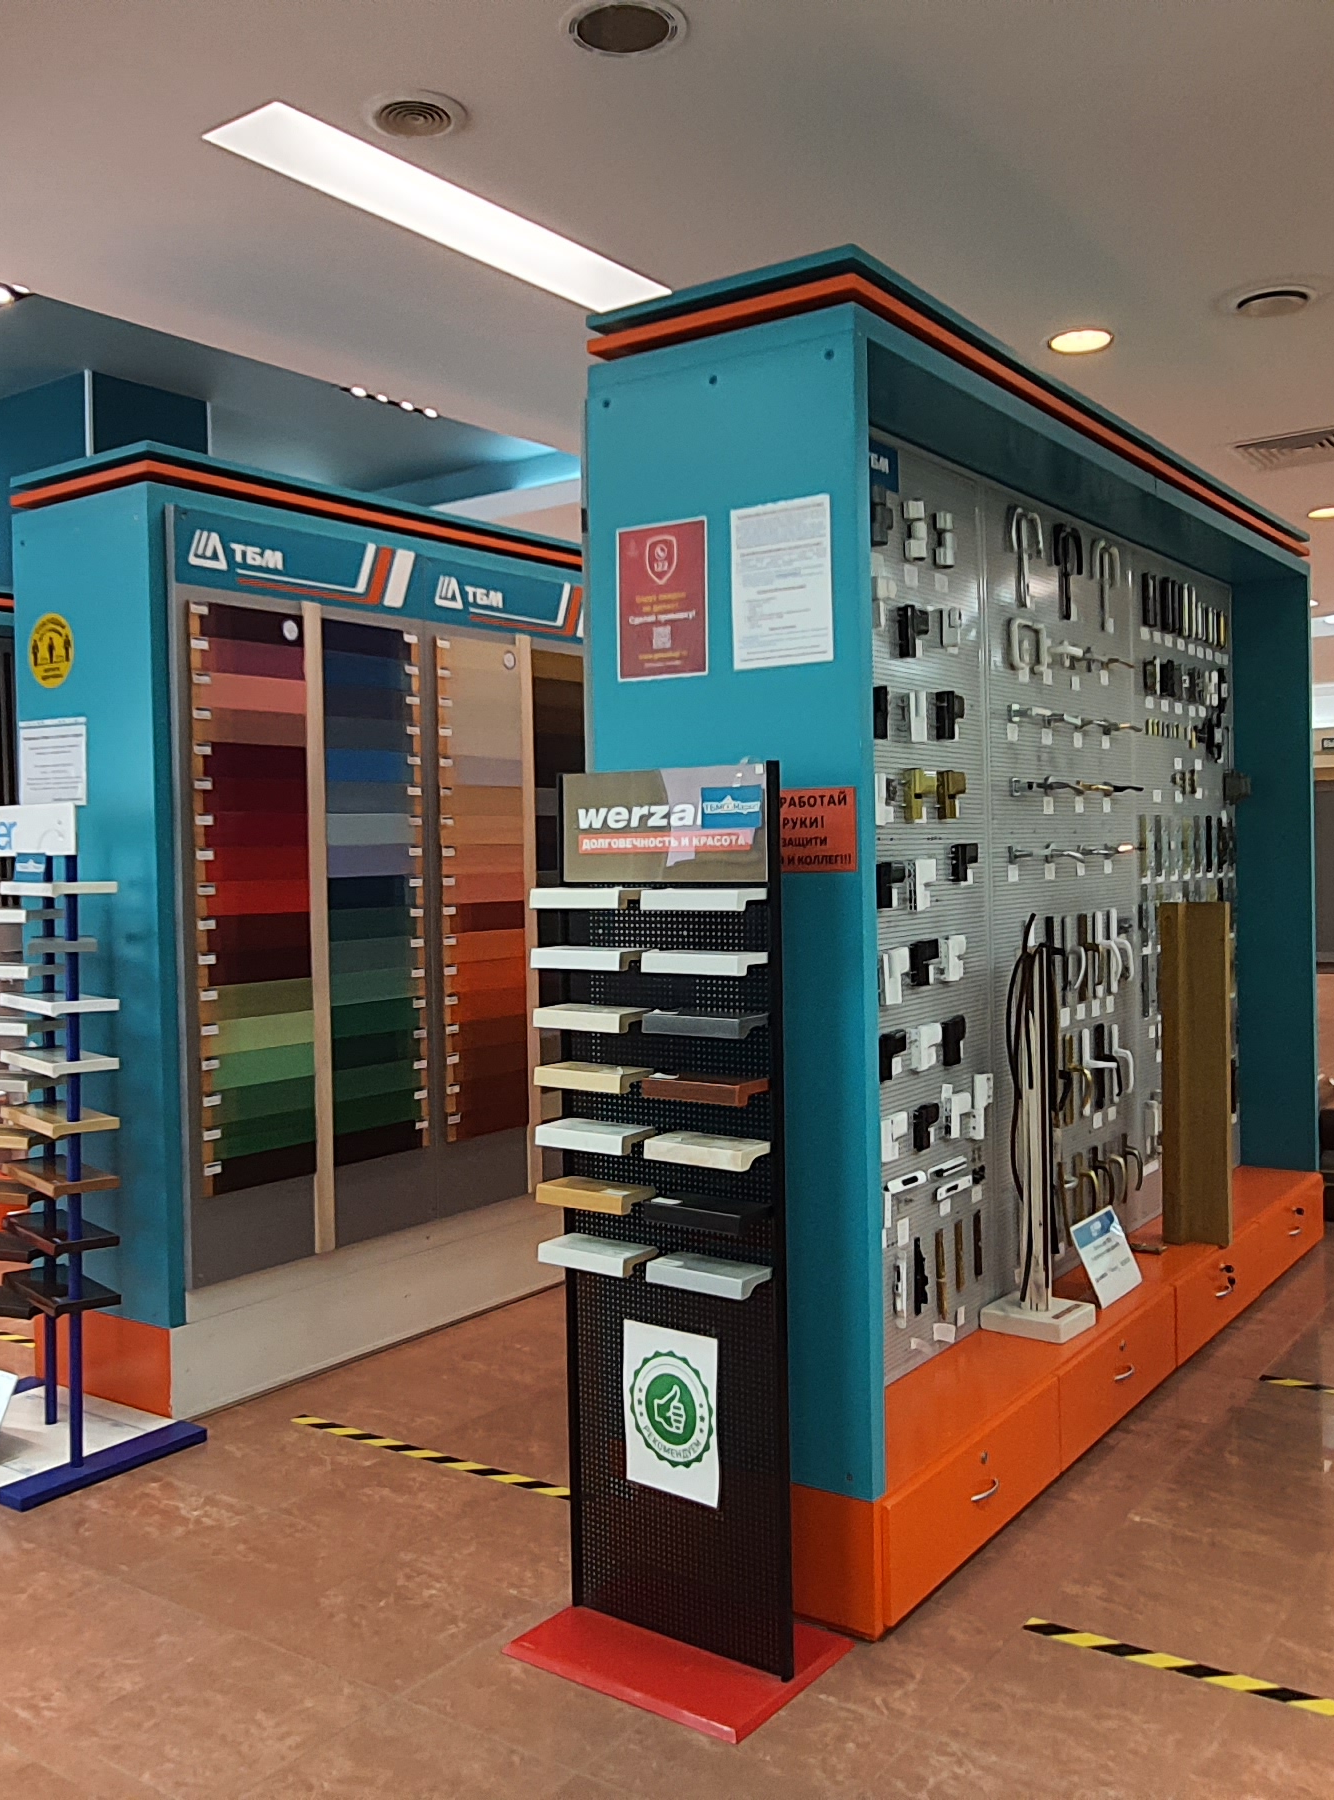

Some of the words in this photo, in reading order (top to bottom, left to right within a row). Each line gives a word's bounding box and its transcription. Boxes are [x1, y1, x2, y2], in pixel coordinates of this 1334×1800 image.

[870, 453, 889, 474] БМ
[230, 542, 283, 571] ТБМ
[464, 585, 503, 608] ТБМ
[779, 790, 847, 808] РАБОТАЙ
[578, 800, 701, 829] werzal
[582, 837, 678, 850] ДОЛГОВЕЧНОСТЬ
[681, 837, 689, 847] И
[693, 834, 746, 847] КРАСОТА
[643, 1425, 702, 1459] РЕКОМЕНДУЕМ
